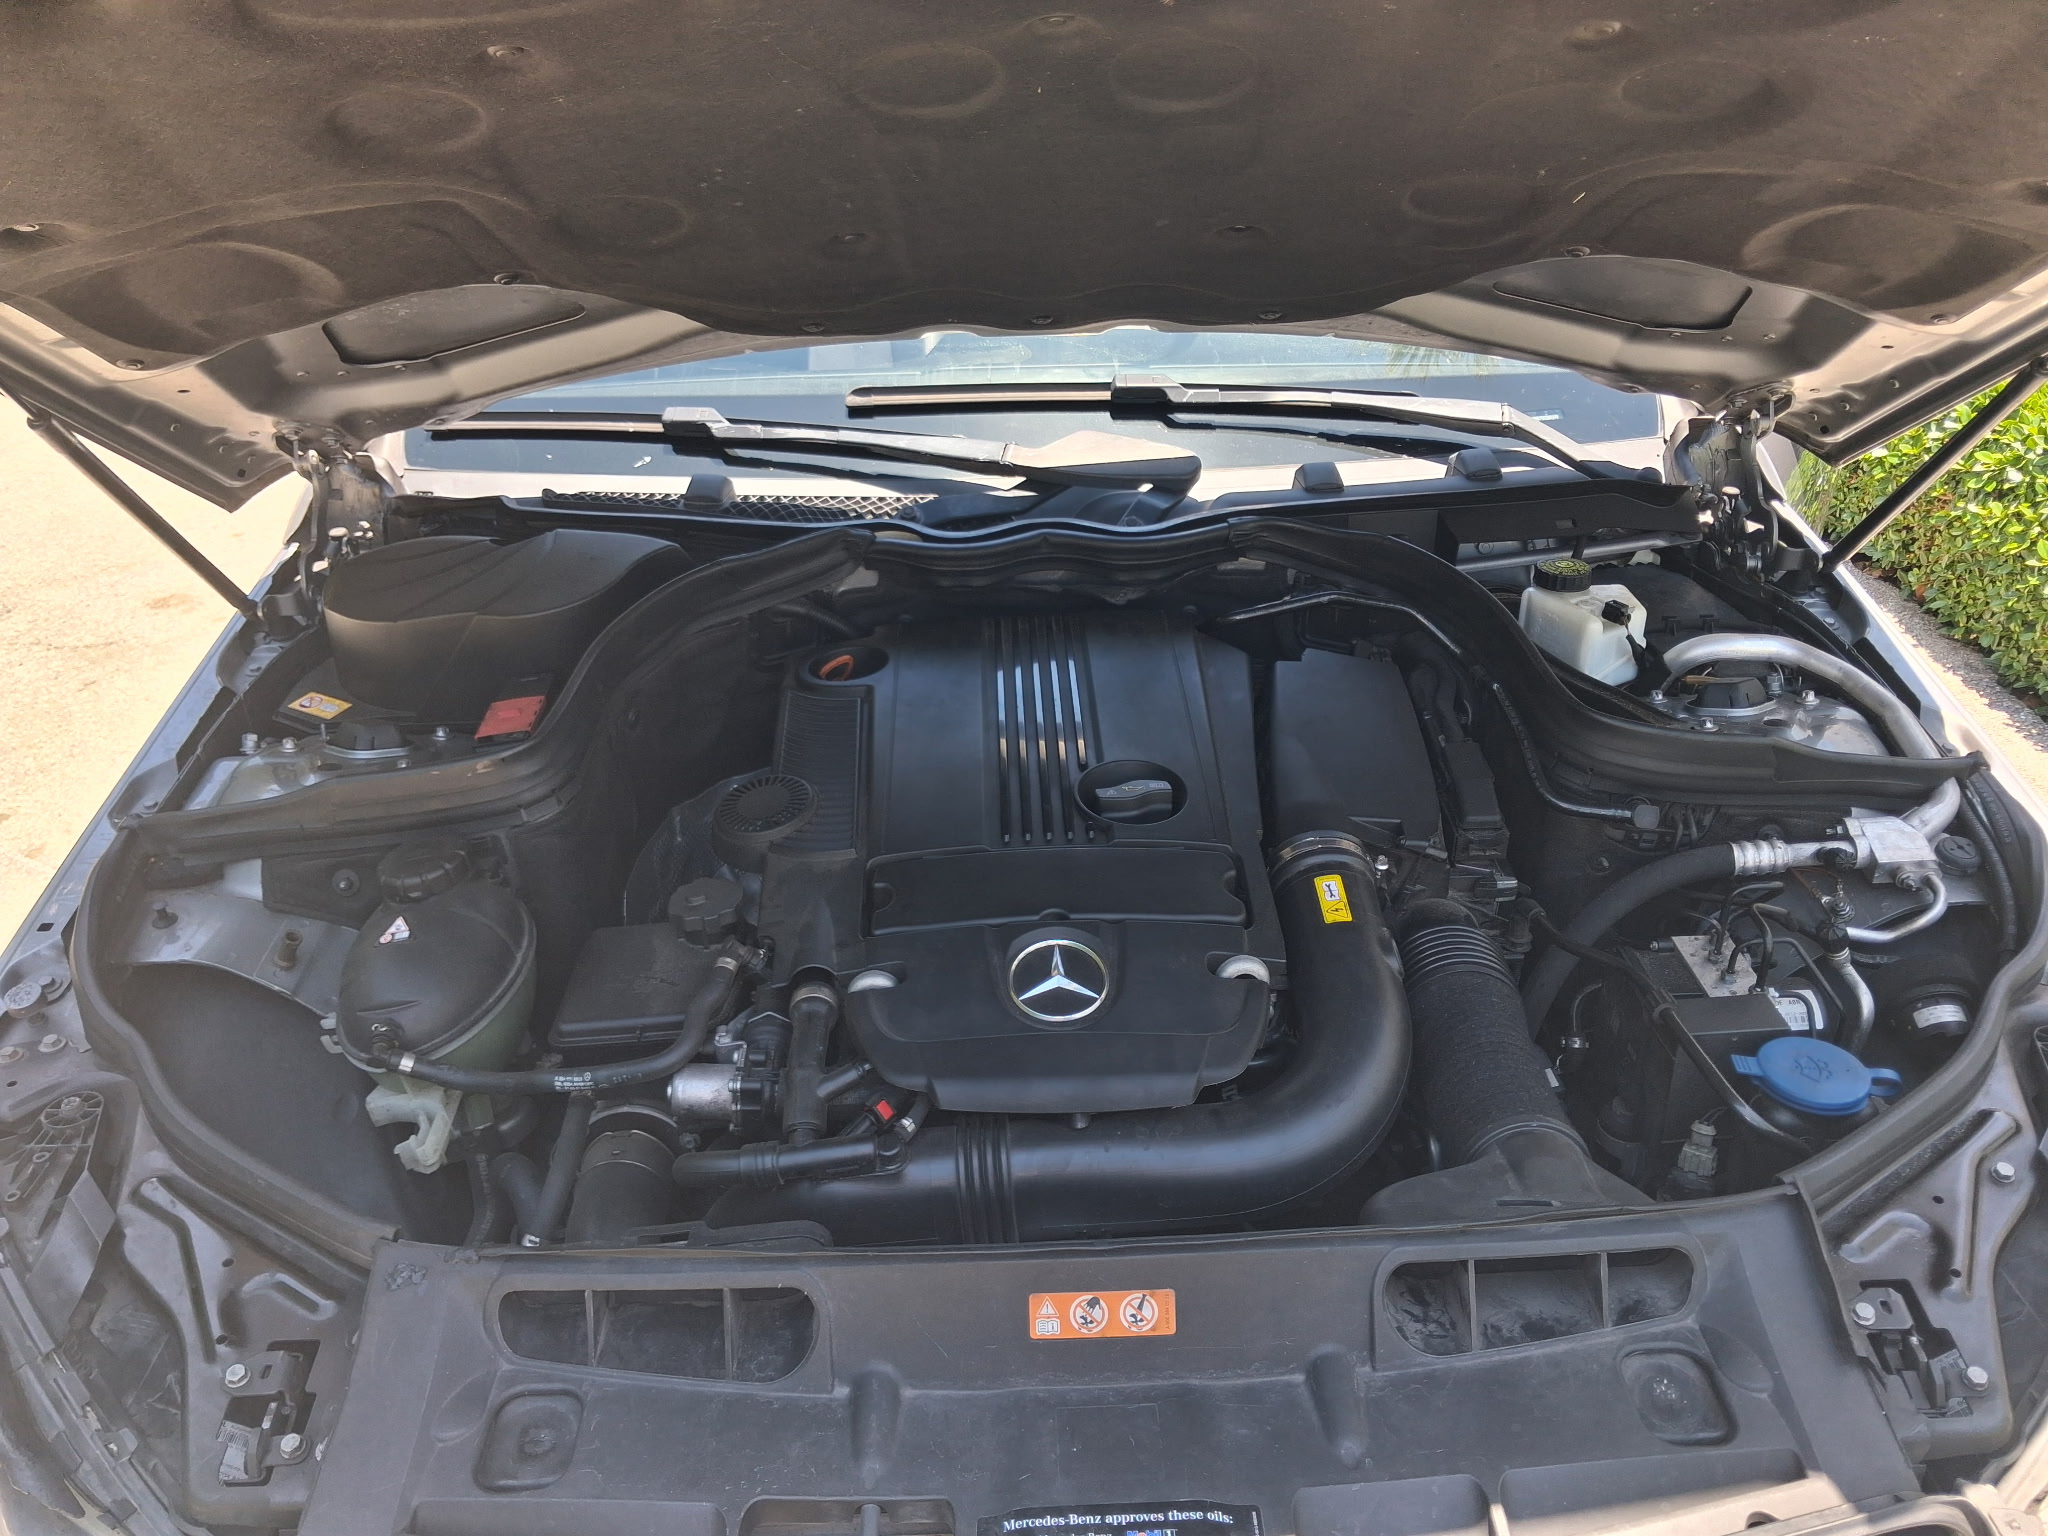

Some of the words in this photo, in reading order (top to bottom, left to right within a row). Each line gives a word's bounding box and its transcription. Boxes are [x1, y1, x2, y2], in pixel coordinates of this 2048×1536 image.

[1002, 1513, 1102, 1533] Mercedes-Benz
[1105, 1511, 1165, 1526] approves
[1168, 1509, 1204, 1521] these
[1207, 1510, 1234, 1524] oils:
